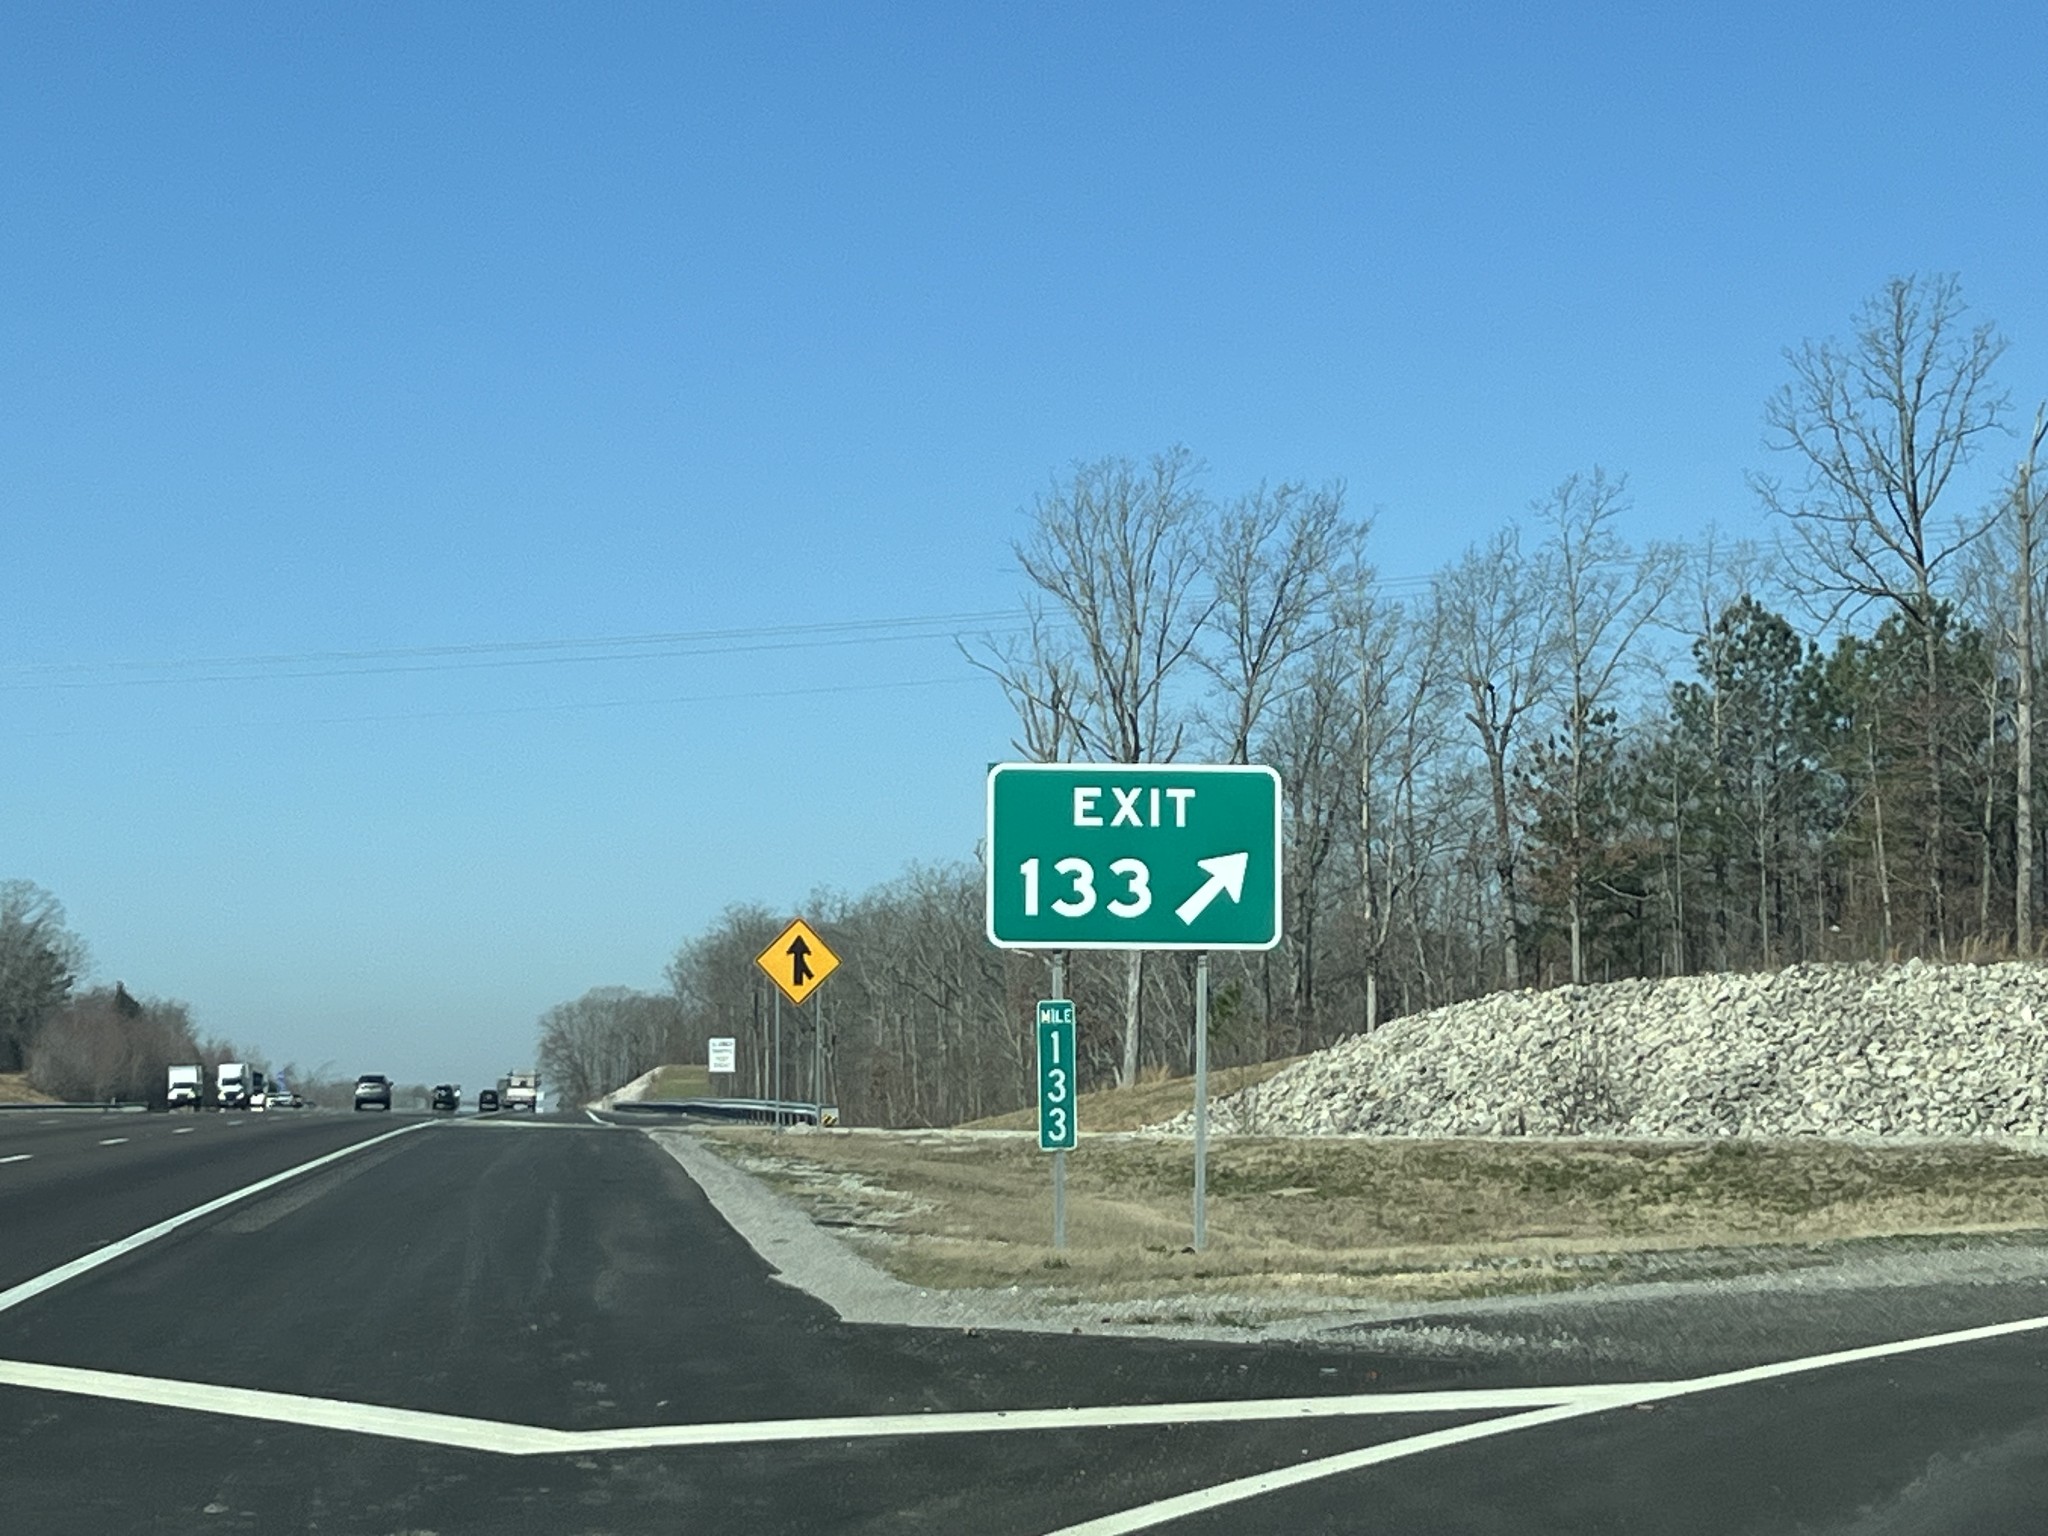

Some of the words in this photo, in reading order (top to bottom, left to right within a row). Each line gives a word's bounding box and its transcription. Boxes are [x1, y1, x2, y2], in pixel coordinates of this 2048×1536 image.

[1073, 787, 1196, 827] EXIT
[1020, 857, 1152, 918] 133
[1040, 1008, 1073, 1024] MILE
[1047, 1031, 1067, 1142] 133
